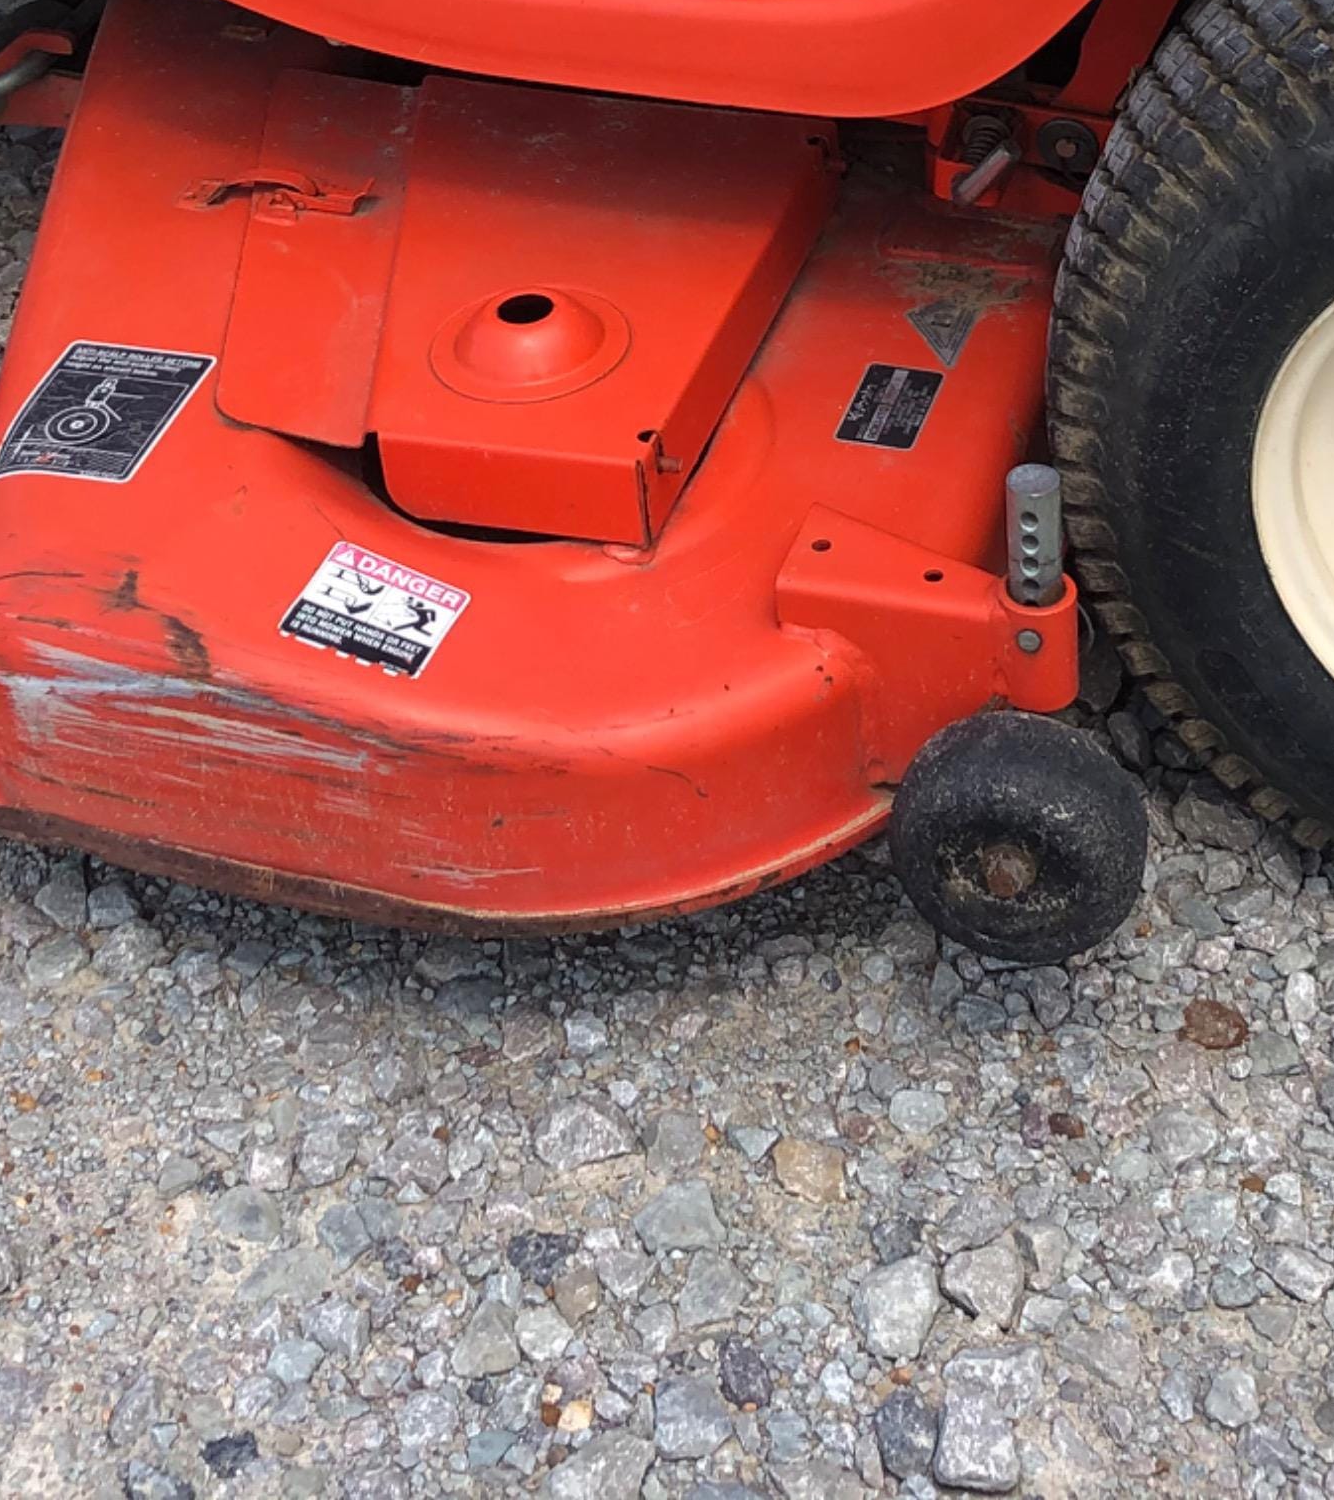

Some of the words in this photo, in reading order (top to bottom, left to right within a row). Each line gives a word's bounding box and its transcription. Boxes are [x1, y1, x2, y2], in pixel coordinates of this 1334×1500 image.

[356, 555, 463, 608] DANGER
[295, 611, 318, 625] INTO
[317, 619, 354, 638] MOWER
[352, 632, 382, 649] WHEN
[380, 643, 416, 662] ENGINE
[301, 603, 317, 614] DO
[315, 609, 336, 620] NOT
[335, 616, 355, 627] PUT
[353, 623, 386, 640] HANDS
[385, 634, 400, 646] OR
[399, 640, 424, 654] FEET
